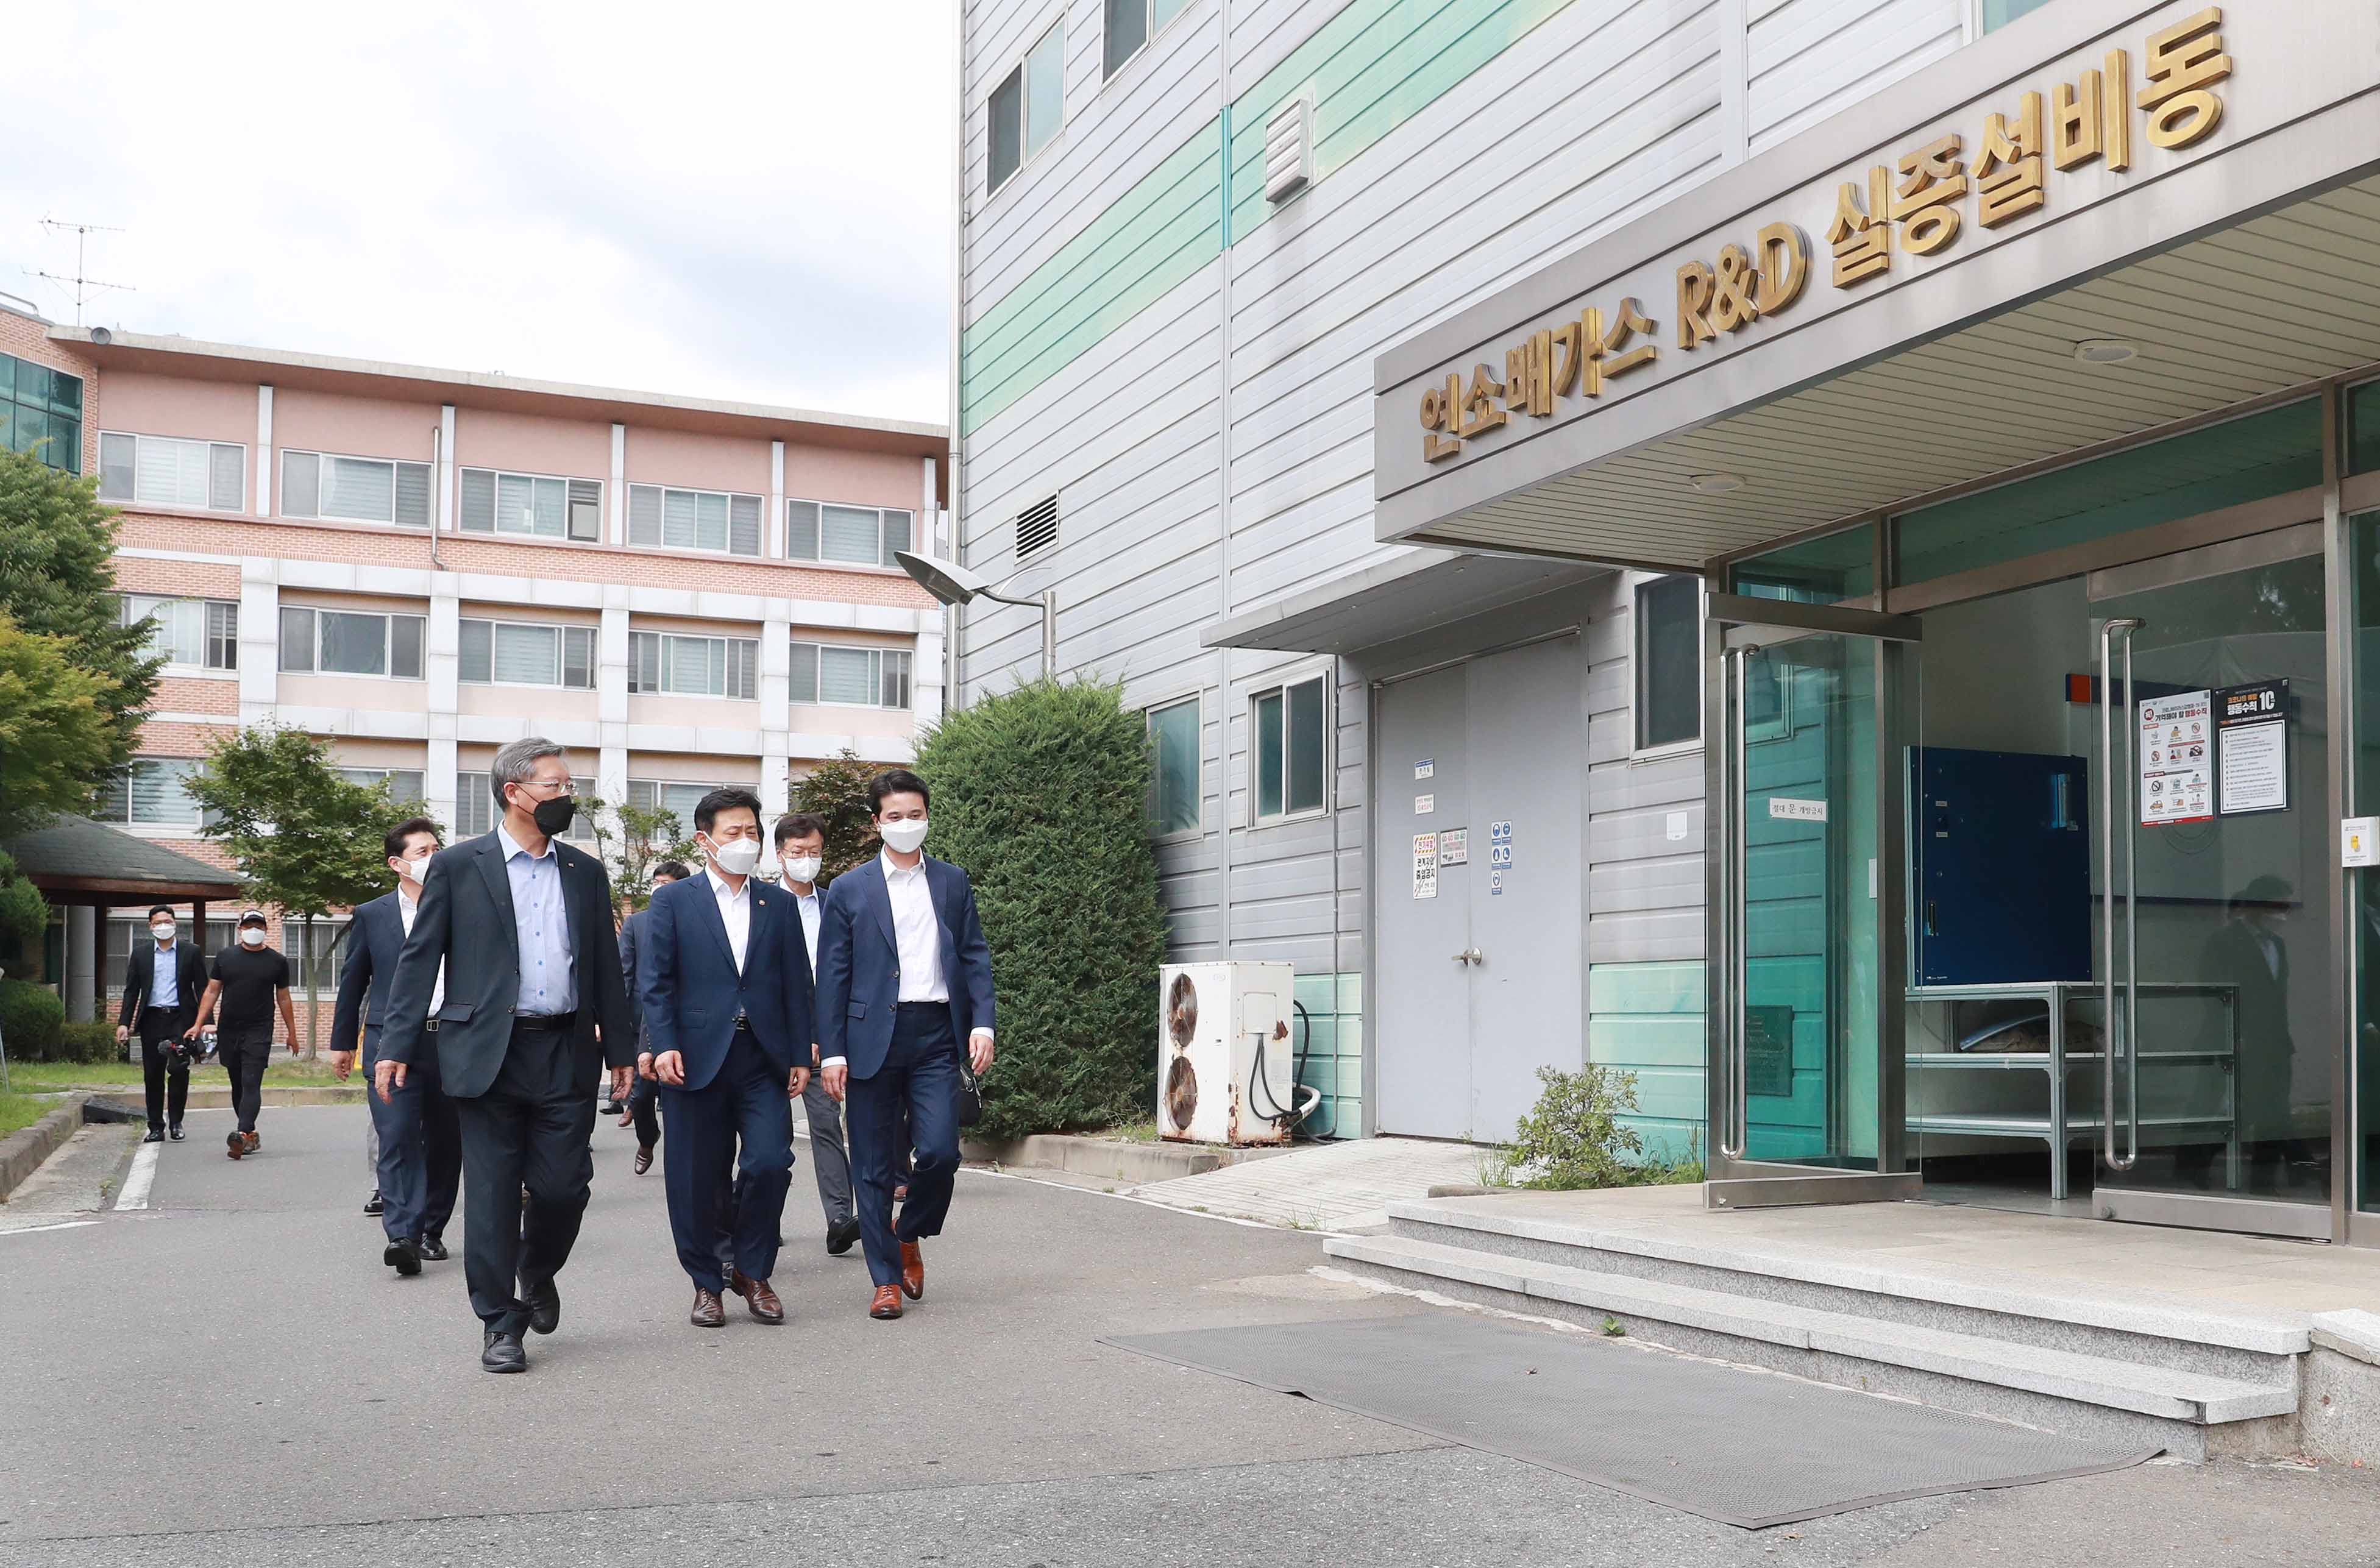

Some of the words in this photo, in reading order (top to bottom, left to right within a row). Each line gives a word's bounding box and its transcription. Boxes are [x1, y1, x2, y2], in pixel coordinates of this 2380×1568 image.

[1420, 295, 1657, 463] 연소배가스
[1675, 221, 1812, 350] R&D
[1825, 5, 2233, 288] 실증설비동
[2227, 701, 2257, 715] 행동수칙
[1788, 804, 1797, 814] 문
[1799, 806, 1823, 815] 개방금지
[1416, 868, 1435, 880] 출입금지
